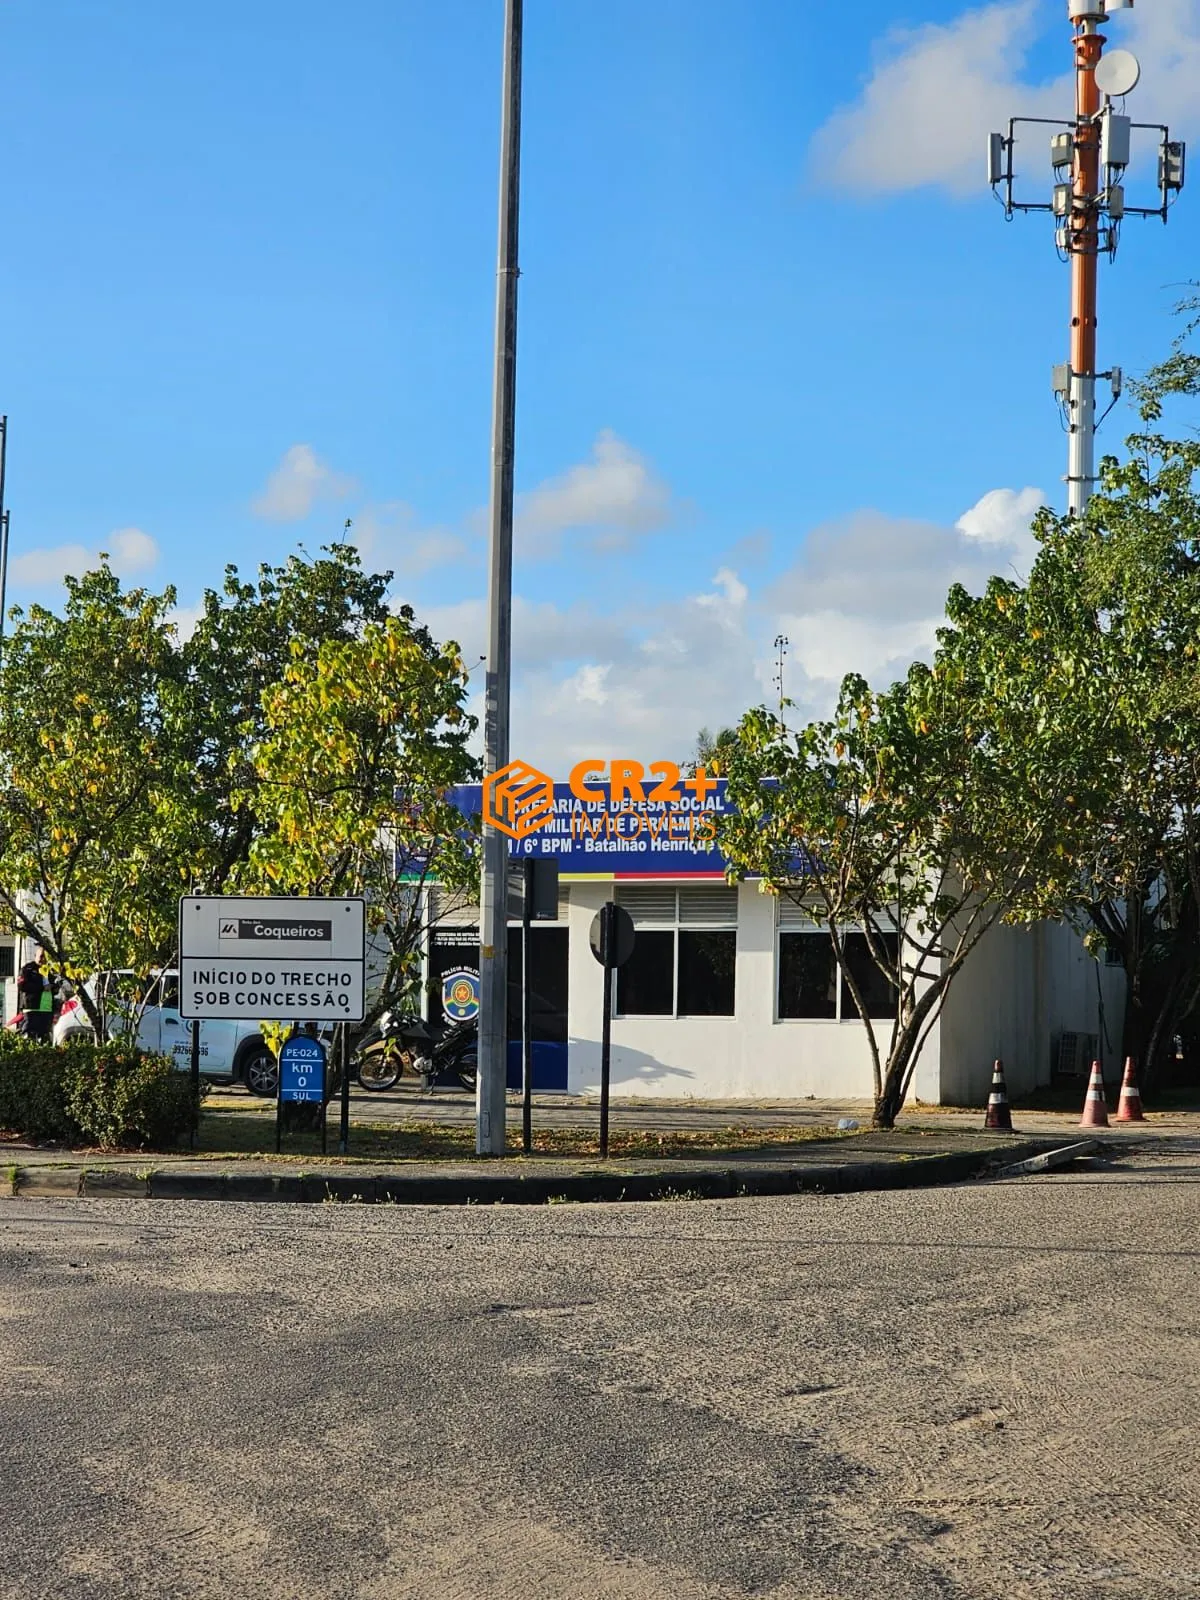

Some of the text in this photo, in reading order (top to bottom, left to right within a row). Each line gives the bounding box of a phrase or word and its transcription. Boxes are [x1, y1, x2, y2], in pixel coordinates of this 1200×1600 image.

[587, 799, 606, 813] DE
[610, 797, 667, 812] DEFESA
[670, 795, 725, 812] SOCIAL
[544, 817, 603, 833] MILITAR
[608, 817, 626, 832] DE
[541, 838, 572, 853] BPM
[584, 837, 647, 853] Batalhão
[254, 925, 324, 939] Coqueiros
[193, 968, 352, 986] INÍCIO DO TRECHO
[193, 989, 349, 1007] SOB CONCESSÃO
[286, 1048, 318, 1057] PE-024
[292, 1062, 313, 1073] km
[298, 1076, 307, 1087] 0
[292, 1091, 312, 1100] SUL
